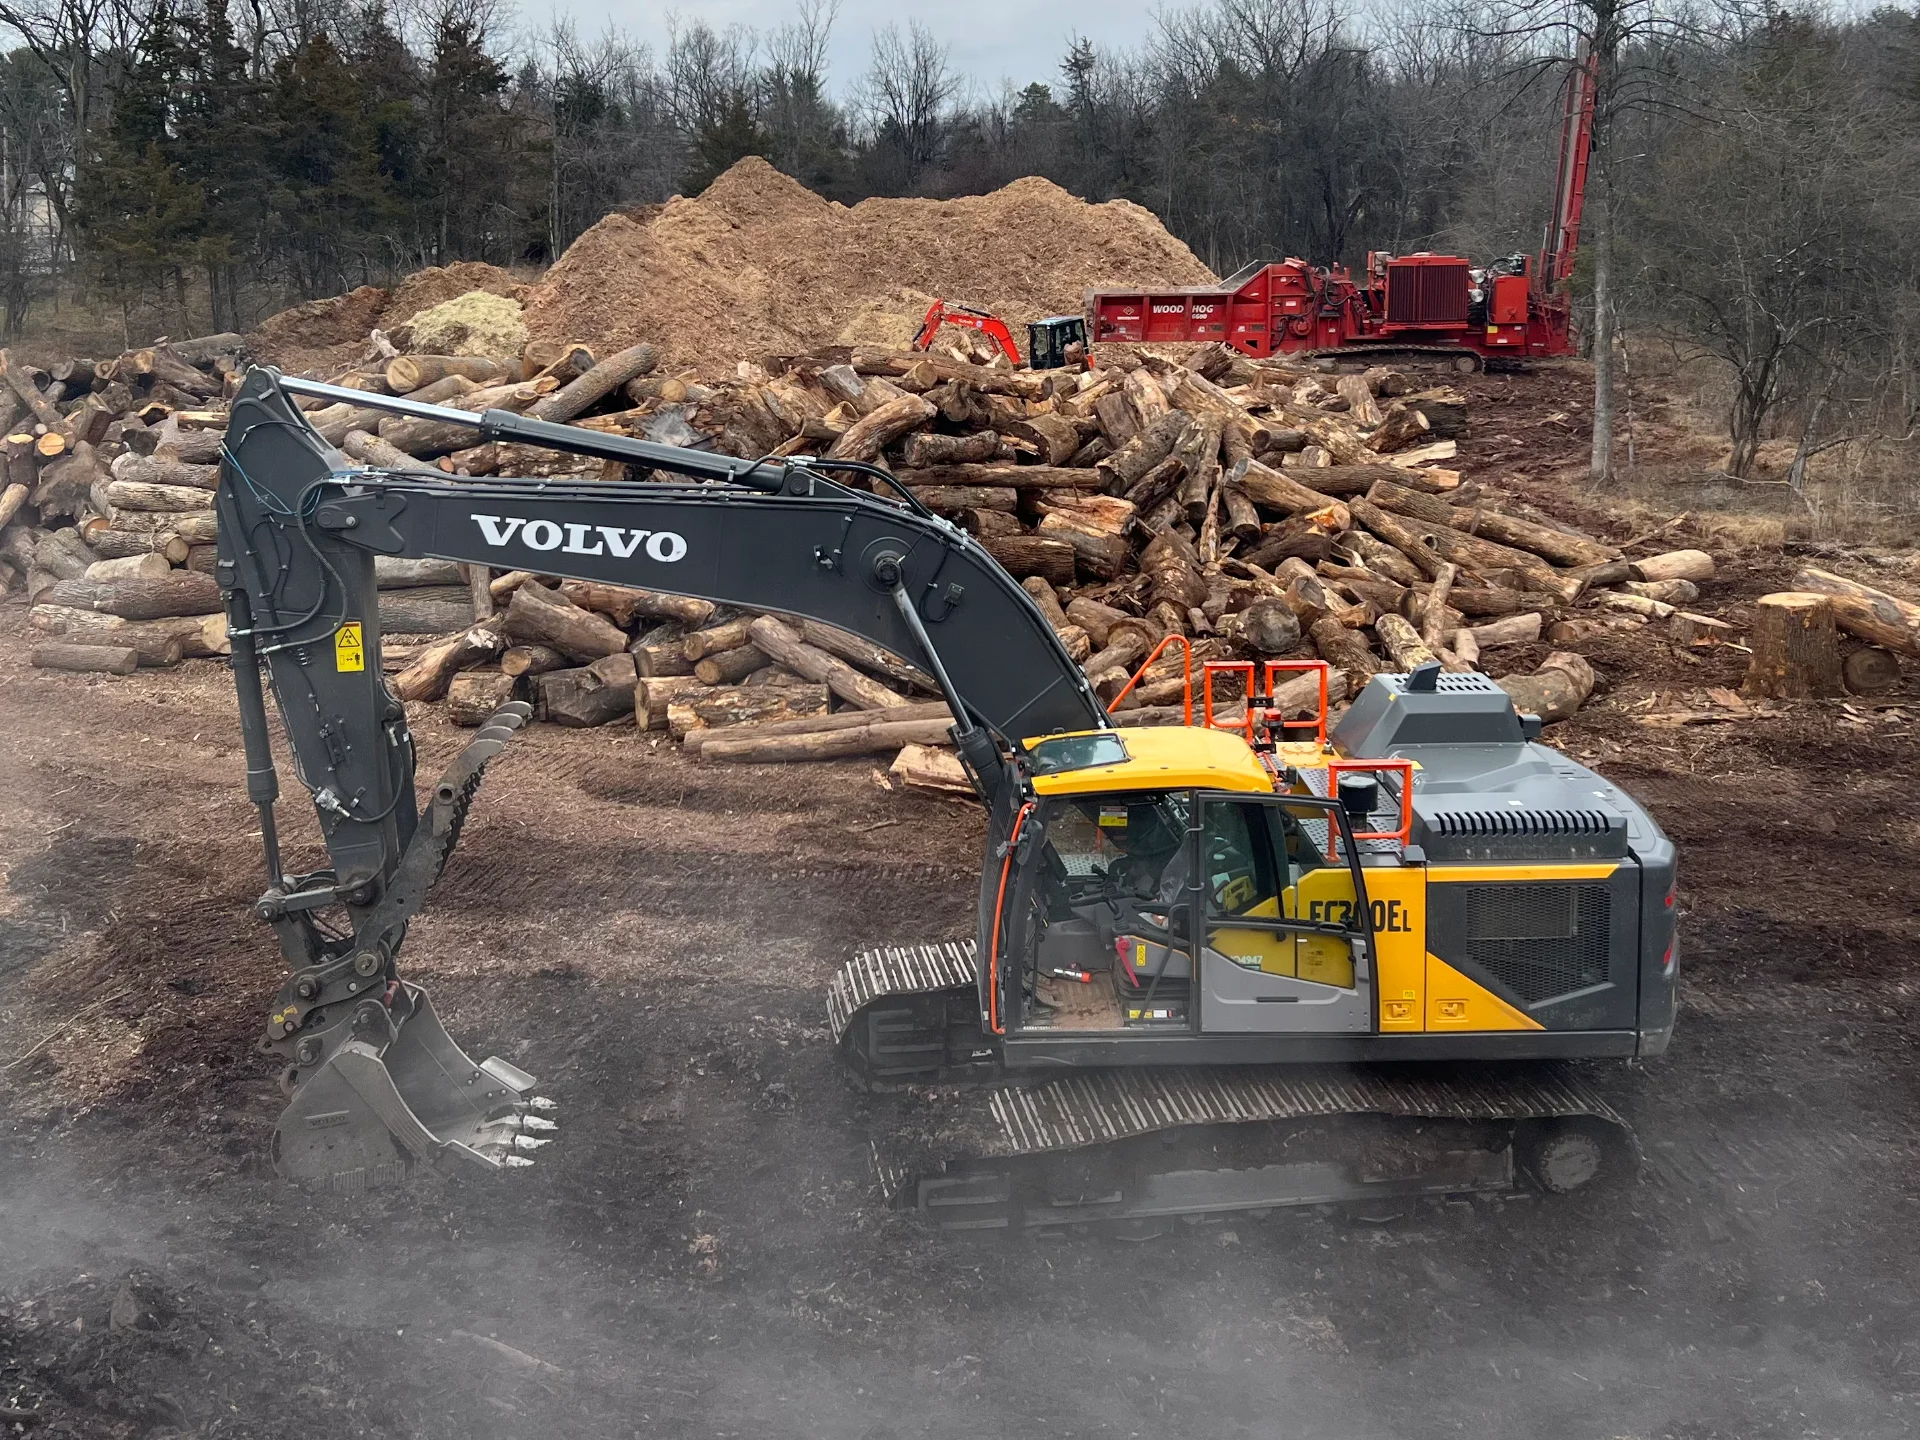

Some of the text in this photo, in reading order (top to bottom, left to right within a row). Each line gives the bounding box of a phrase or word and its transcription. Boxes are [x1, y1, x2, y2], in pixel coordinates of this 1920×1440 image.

[1153, 304, 1214, 314] WOOD HOG
[471, 514, 688, 563] VOLVO
